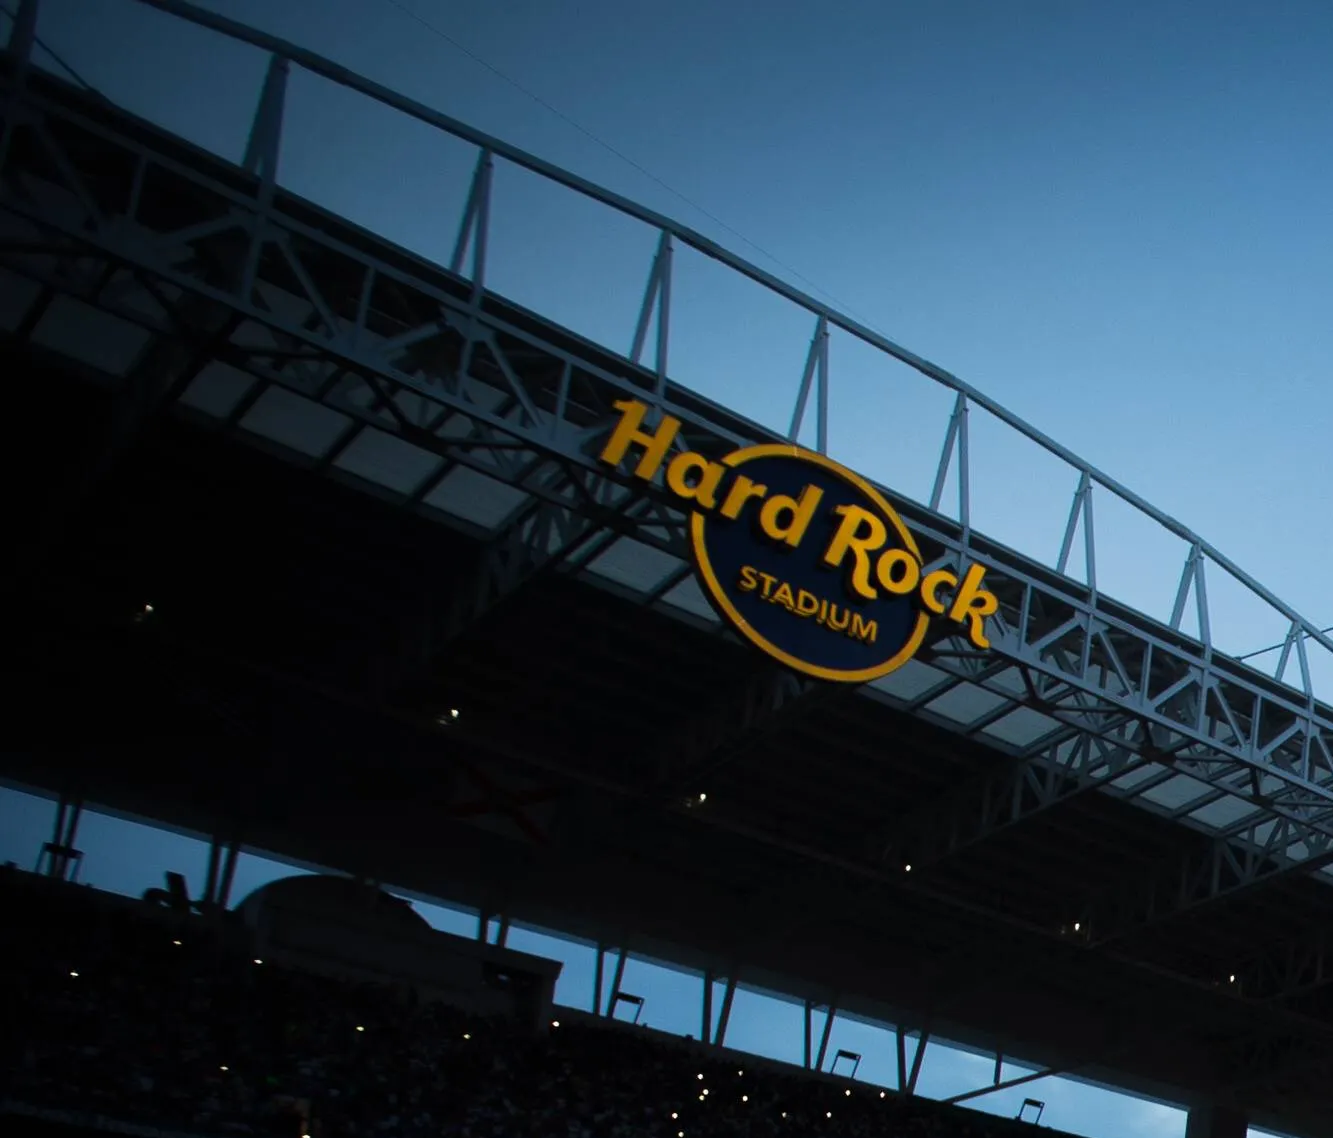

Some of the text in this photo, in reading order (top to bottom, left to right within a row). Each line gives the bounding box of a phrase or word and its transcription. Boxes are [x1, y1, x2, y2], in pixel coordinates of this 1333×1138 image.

[600, 398, 998, 650] Hard Rock
[738, 563, 879, 643] STADIUM
